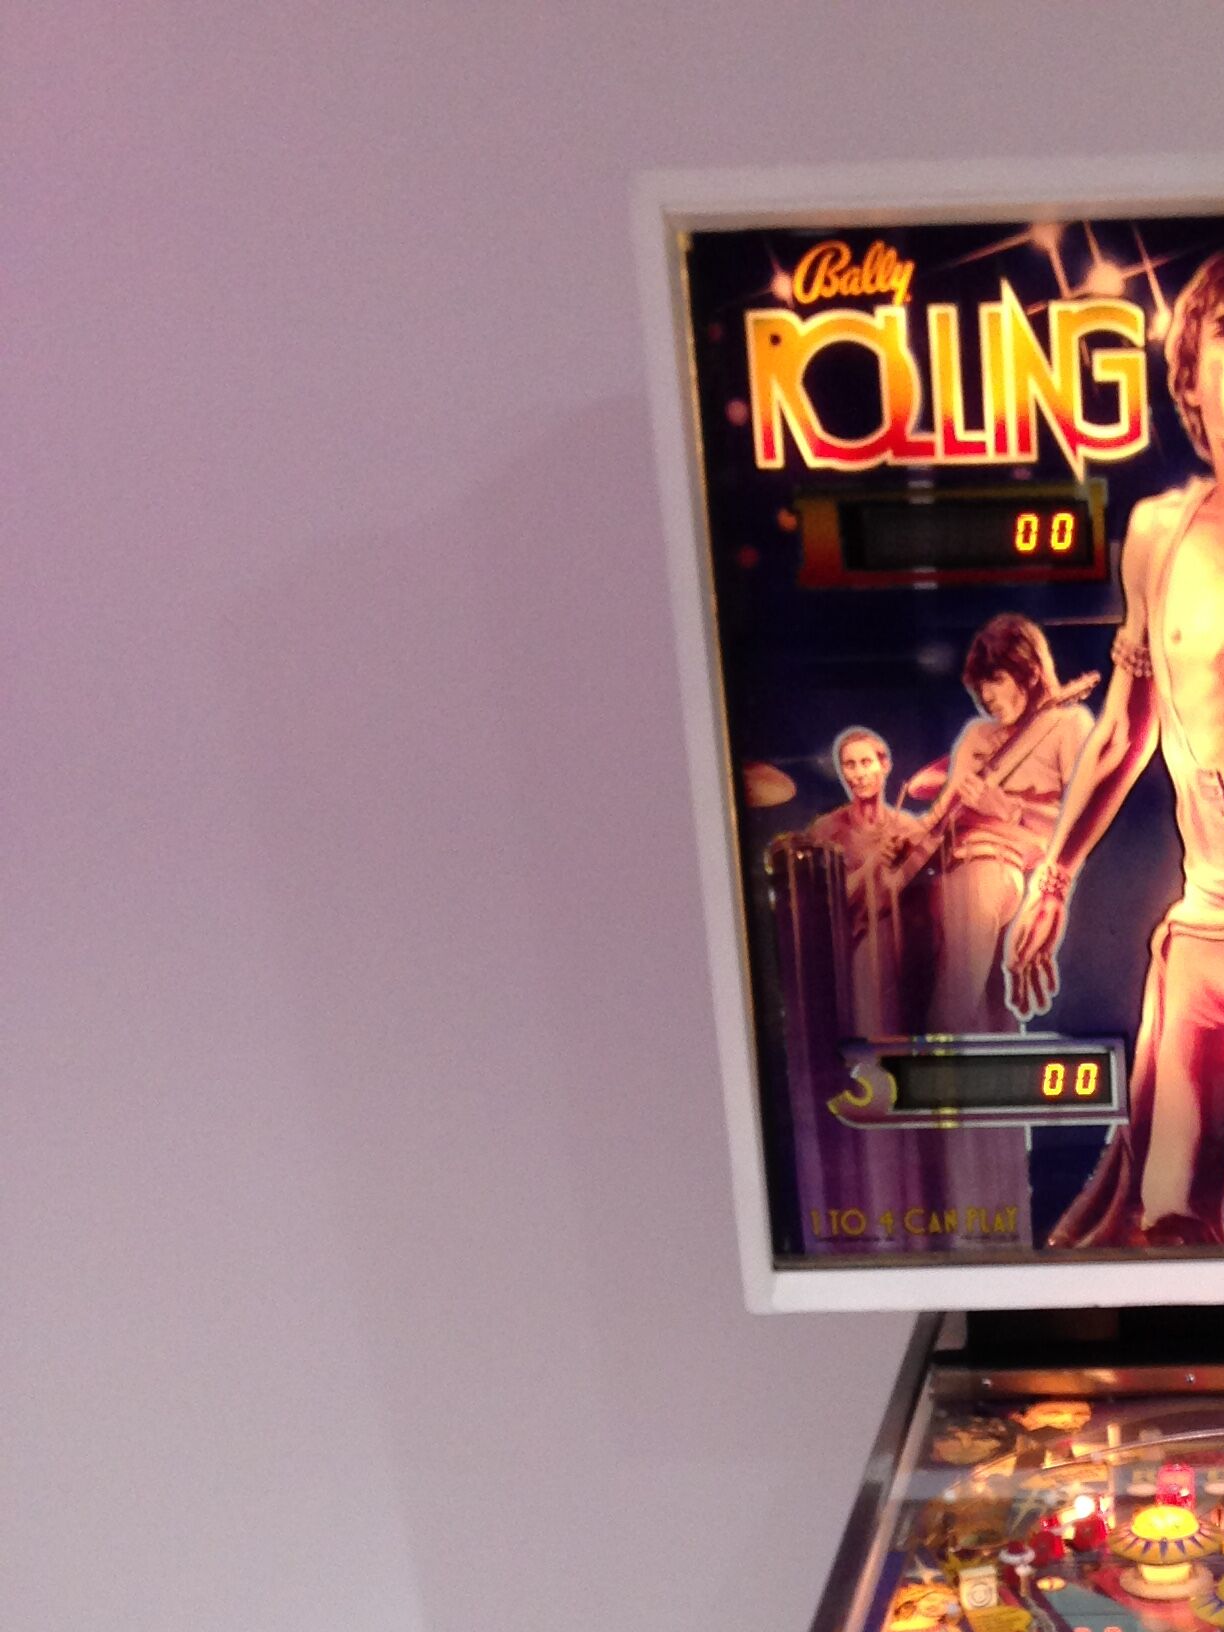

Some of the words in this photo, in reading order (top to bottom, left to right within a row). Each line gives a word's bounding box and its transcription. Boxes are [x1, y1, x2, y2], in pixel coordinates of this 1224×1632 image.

[793, 240, 915, 305] Bally
[744, 278, 1150, 484] ROLLING
[829, 1207, 867, 1236] TO
[904, 1208, 958, 1236] CAN
[965, 1206, 1017, 1233] PLAY
